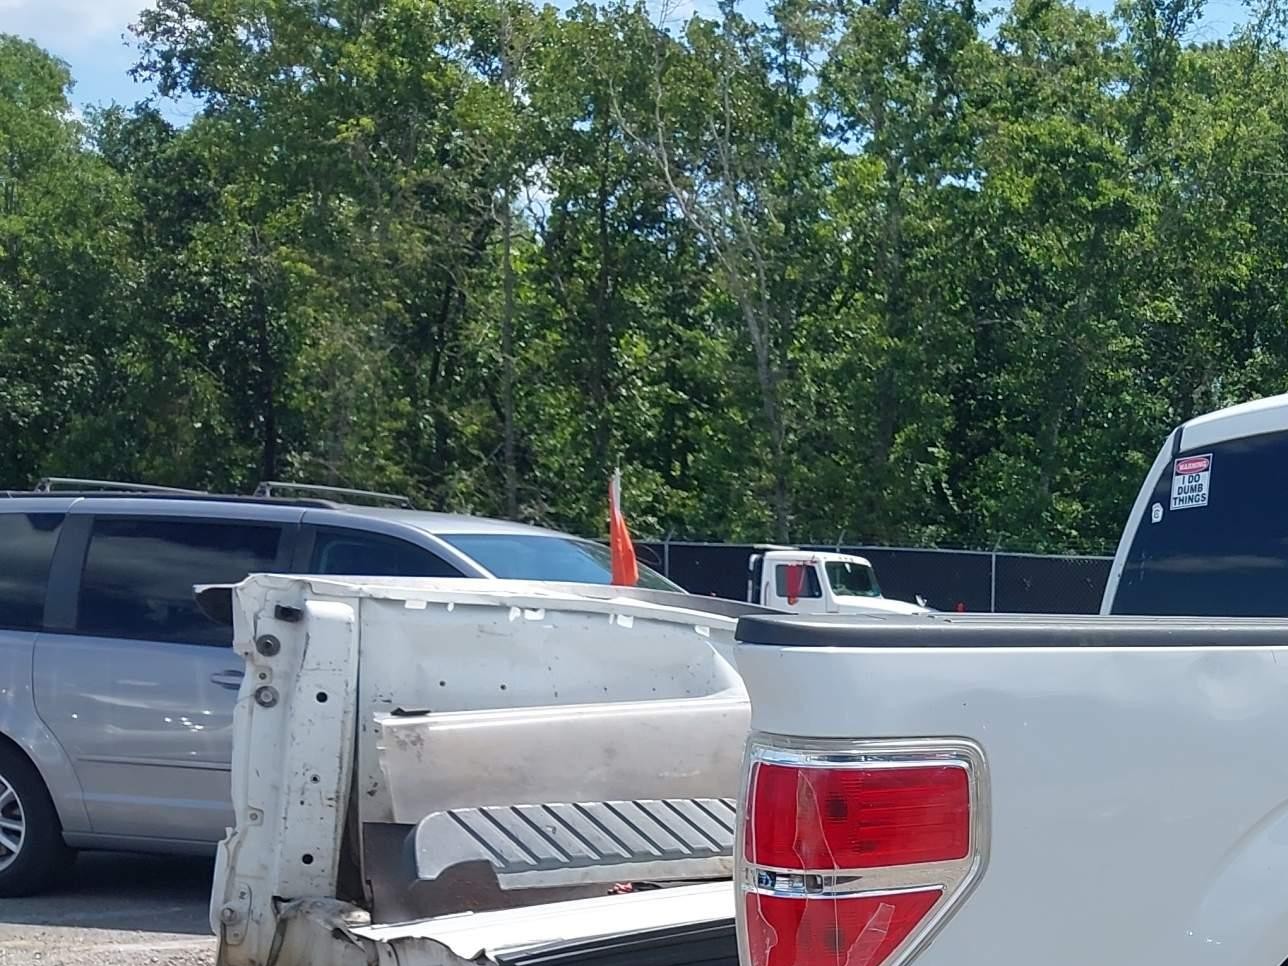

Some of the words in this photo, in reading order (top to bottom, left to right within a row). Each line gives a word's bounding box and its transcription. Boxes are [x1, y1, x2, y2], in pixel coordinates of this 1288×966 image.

[1182, 475, 1186, 484] I
[1188, 473, 1201, 484] DO
[1177, 483, 1203, 495] DUMB
[1172, 493, 1206, 506] THINGS
